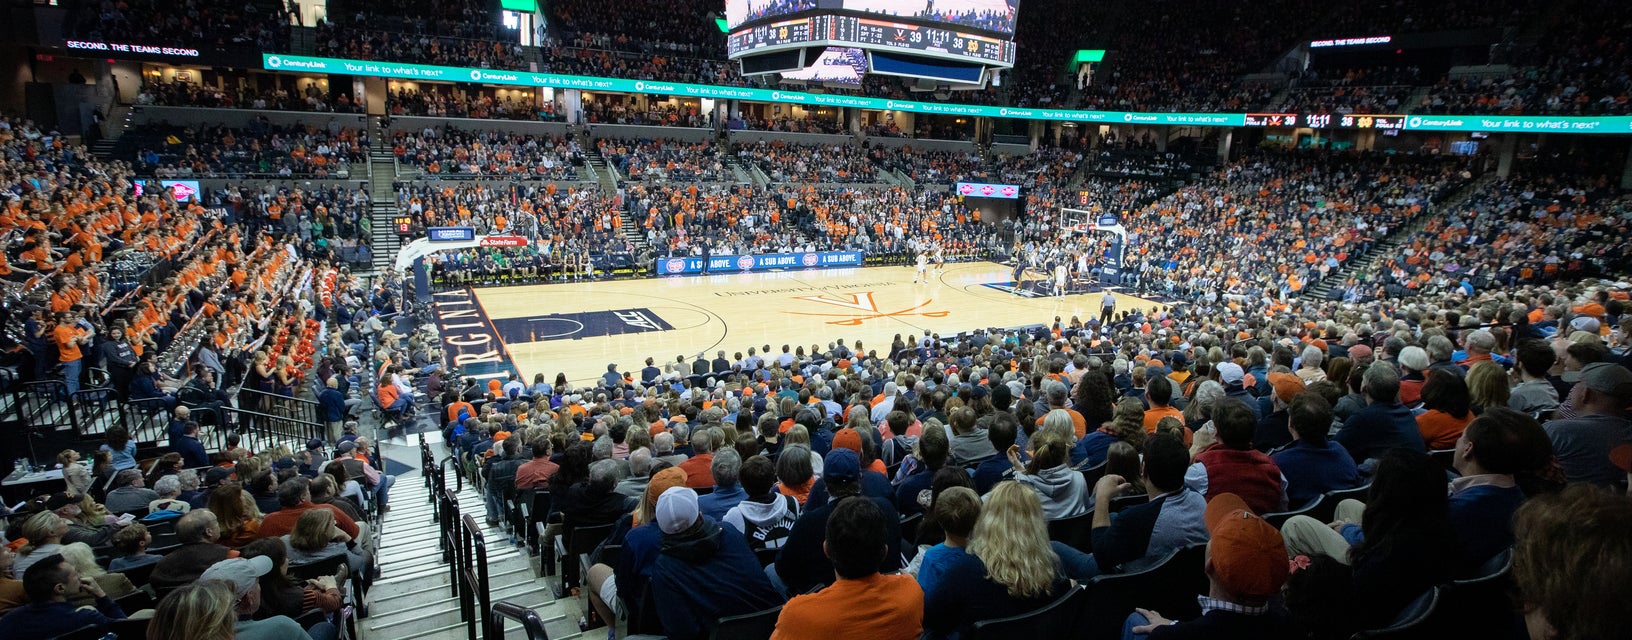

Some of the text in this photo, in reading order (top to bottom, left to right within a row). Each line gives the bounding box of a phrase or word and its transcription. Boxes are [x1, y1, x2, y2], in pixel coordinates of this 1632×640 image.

[909, 31, 922, 43] 39
[926, 29, 950, 43] 11:11
[67, 40, 199, 57] SECOND. THE TEAMS SECOND
[953, 38, 963, 49] 38
[284, 59, 326, 69] CenturyLink
[344, 62, 363, 72] Your
[365, 64, 379, 73] link
[382, 66, 391, 74] to
[393, 67, 419, 76] what's
[483, 72, 518, 81] CenturyLink
[532, 75, 547, 84] Your
[549, 77, 561, 85] link
[571, 79, 593, 87] what's
[686, 86, 700, 94] Your
[719, 89, 737, 97] what's
[1284, 116, 1296, 126] 39
[1306, 114, 1331, 125] 11:11
[1341, 116, 1353, 127] 38
[1422, 119, 1465, 128] CenturyLink
[1481, 119, 1502, 128] Your
[1503, 119, 1521, 128] link
[1523, 121, 1534, 129] to
[1536, 120, 1569, 129] what's
[759, 256, 765, 265] A
[765, 256, 776, 265] SUB
[777, 256, 796, 265] ABOVE.
[822, 255, 828, 263] A
[828, 254, 838, 263] SUB
[839, 253, 856, 262] ABOVE.
[690, 260, 696, 269] A
[710, 259, 731, 268] ABOVE.
[613, 311, 658, 330] ACC
[432, 288, 511, 380] IRGINIA
